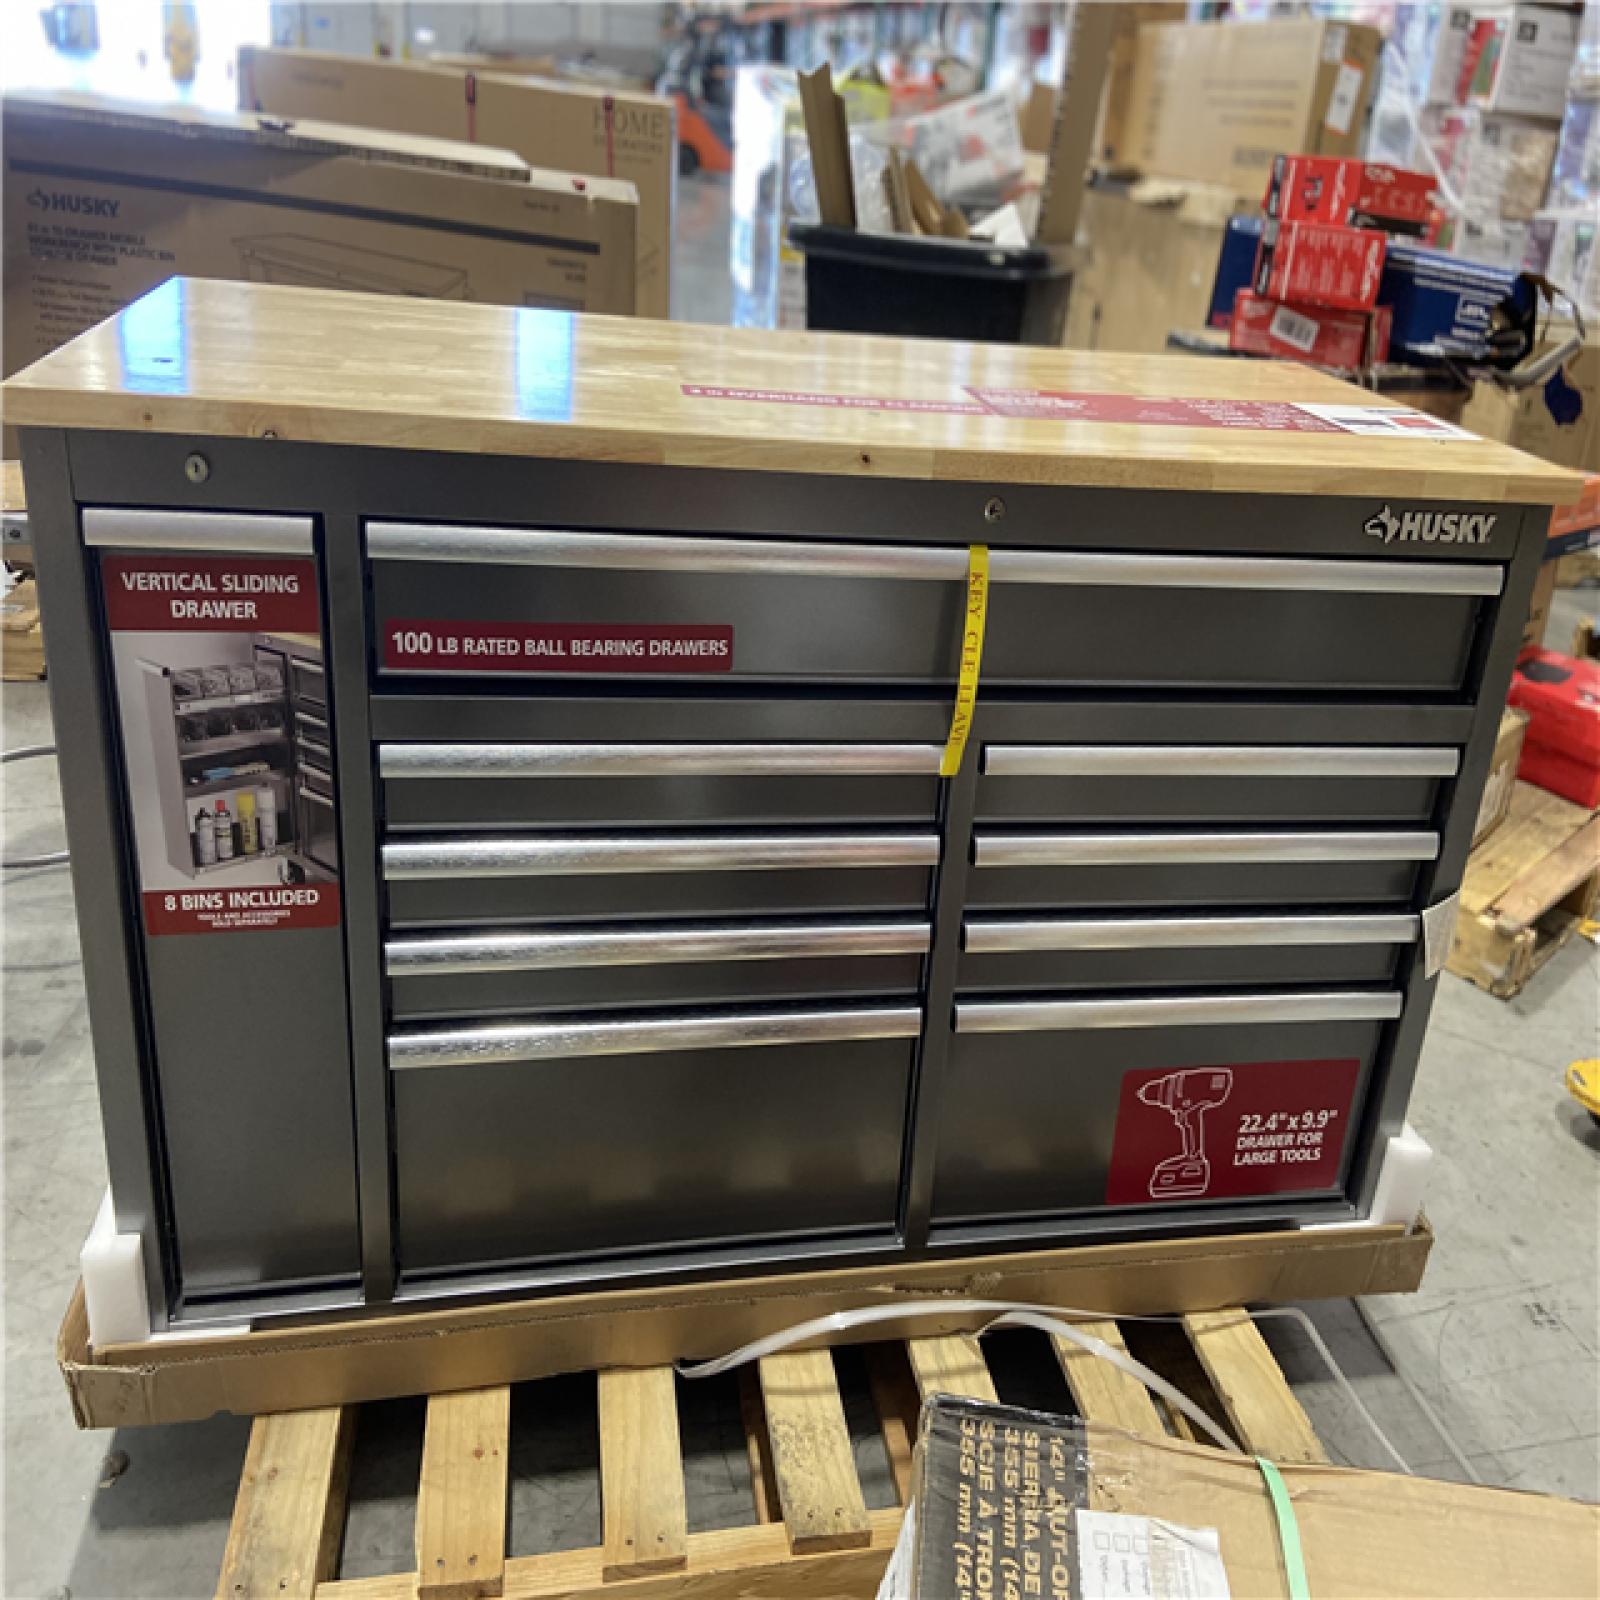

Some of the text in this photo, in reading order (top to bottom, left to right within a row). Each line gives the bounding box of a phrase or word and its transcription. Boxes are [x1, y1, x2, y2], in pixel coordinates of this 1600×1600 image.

[52, 192, 120, 218] HUSKY
[1399, 511, 1498, 544] HUSKY
[120, 571, 300, 594] VERTICAL SLIDING
[170, 599, 258, 619] DRAWER
[391, 631, 729, 656] 100 LB RATED BALL BEARING DRAWERS
[164, 889, 320, 911] 8 BINS INCLUDED
[1301, 1108, 1338, 1130] 9.9"
[1236, 1131, 1323, 1149] DRAWER FOR
[1232, 1146, 1321, 1166] LARGE TOOLS
[979, 1419, 996, 1492] SCIE
[957, 1481, 971, 1534] mm
[1004, 1497, 1017, 1549] mm
[1024, 1551, 1041, 1594] DE
